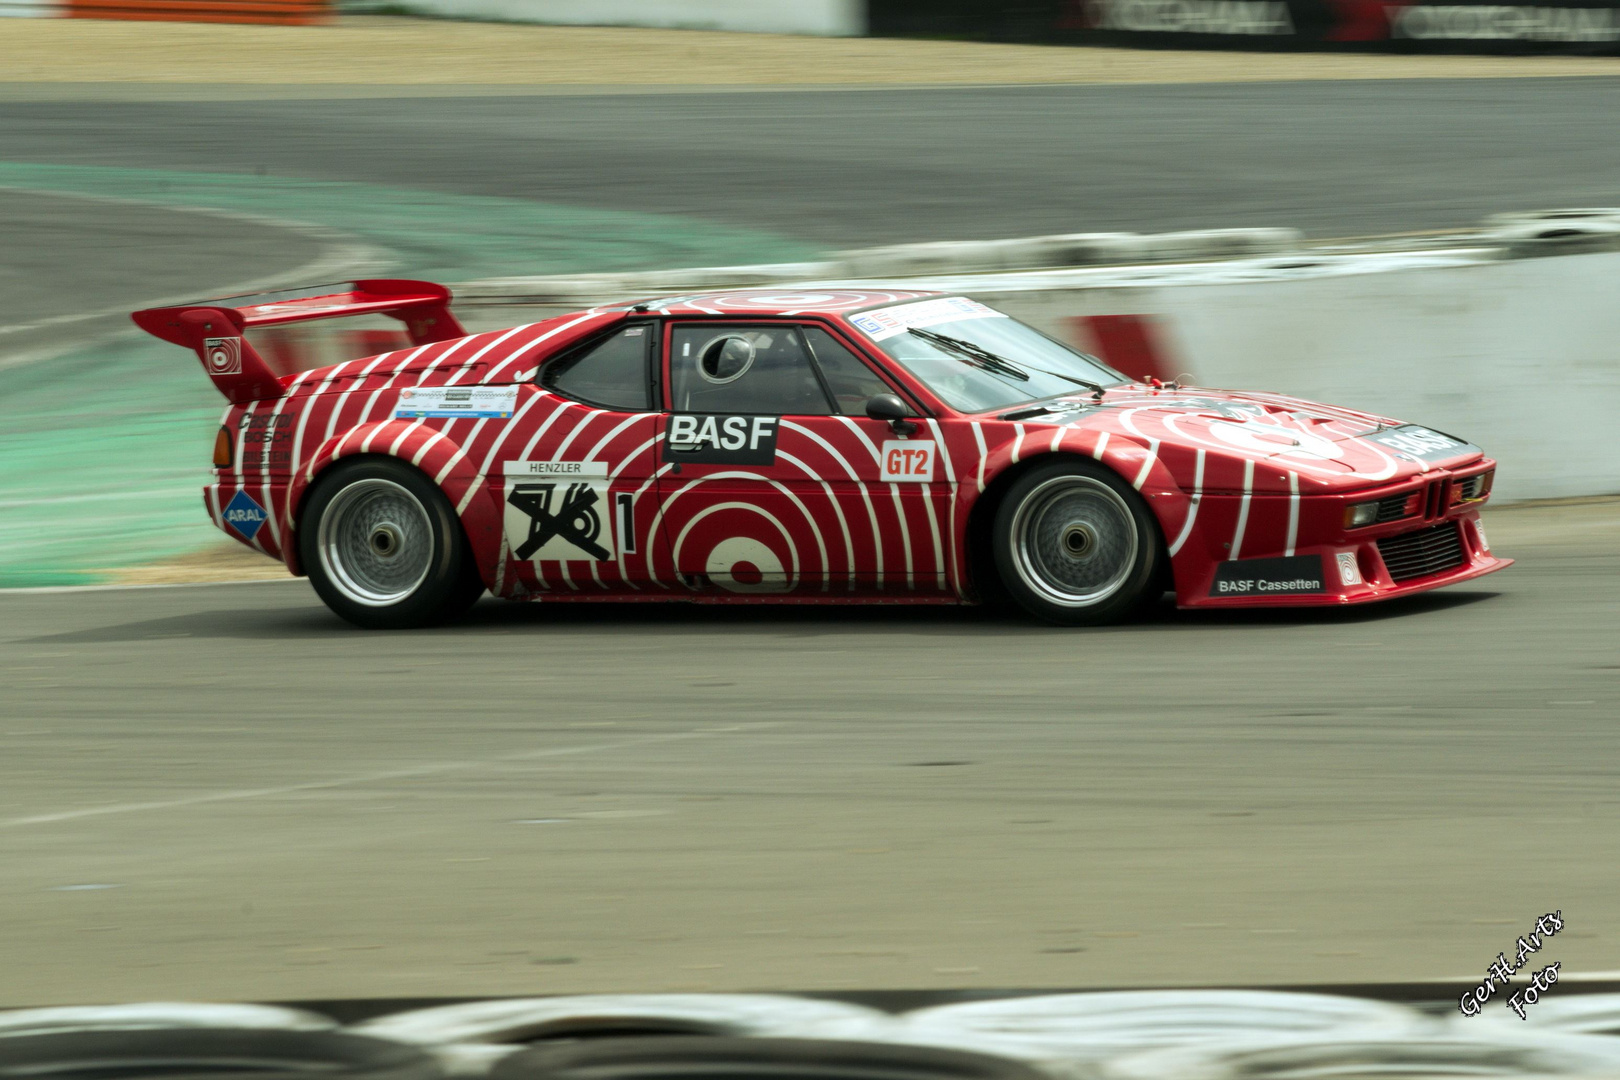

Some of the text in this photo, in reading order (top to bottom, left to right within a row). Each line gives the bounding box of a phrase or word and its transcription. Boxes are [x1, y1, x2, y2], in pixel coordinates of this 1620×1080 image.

[238, 412, 295, 429] Castrol
[244, 431, 292, 443] BOSCH
[669, 416, 776, 450] BASF
[529, 463, 581, 473] HENZLER
[887, 449, 928, 475] GT2
[228, 509, 264, 522] ARAL
[618, 494, 635, 551] 1
[1219, 579, 1320, 592] BASF Cassetten
